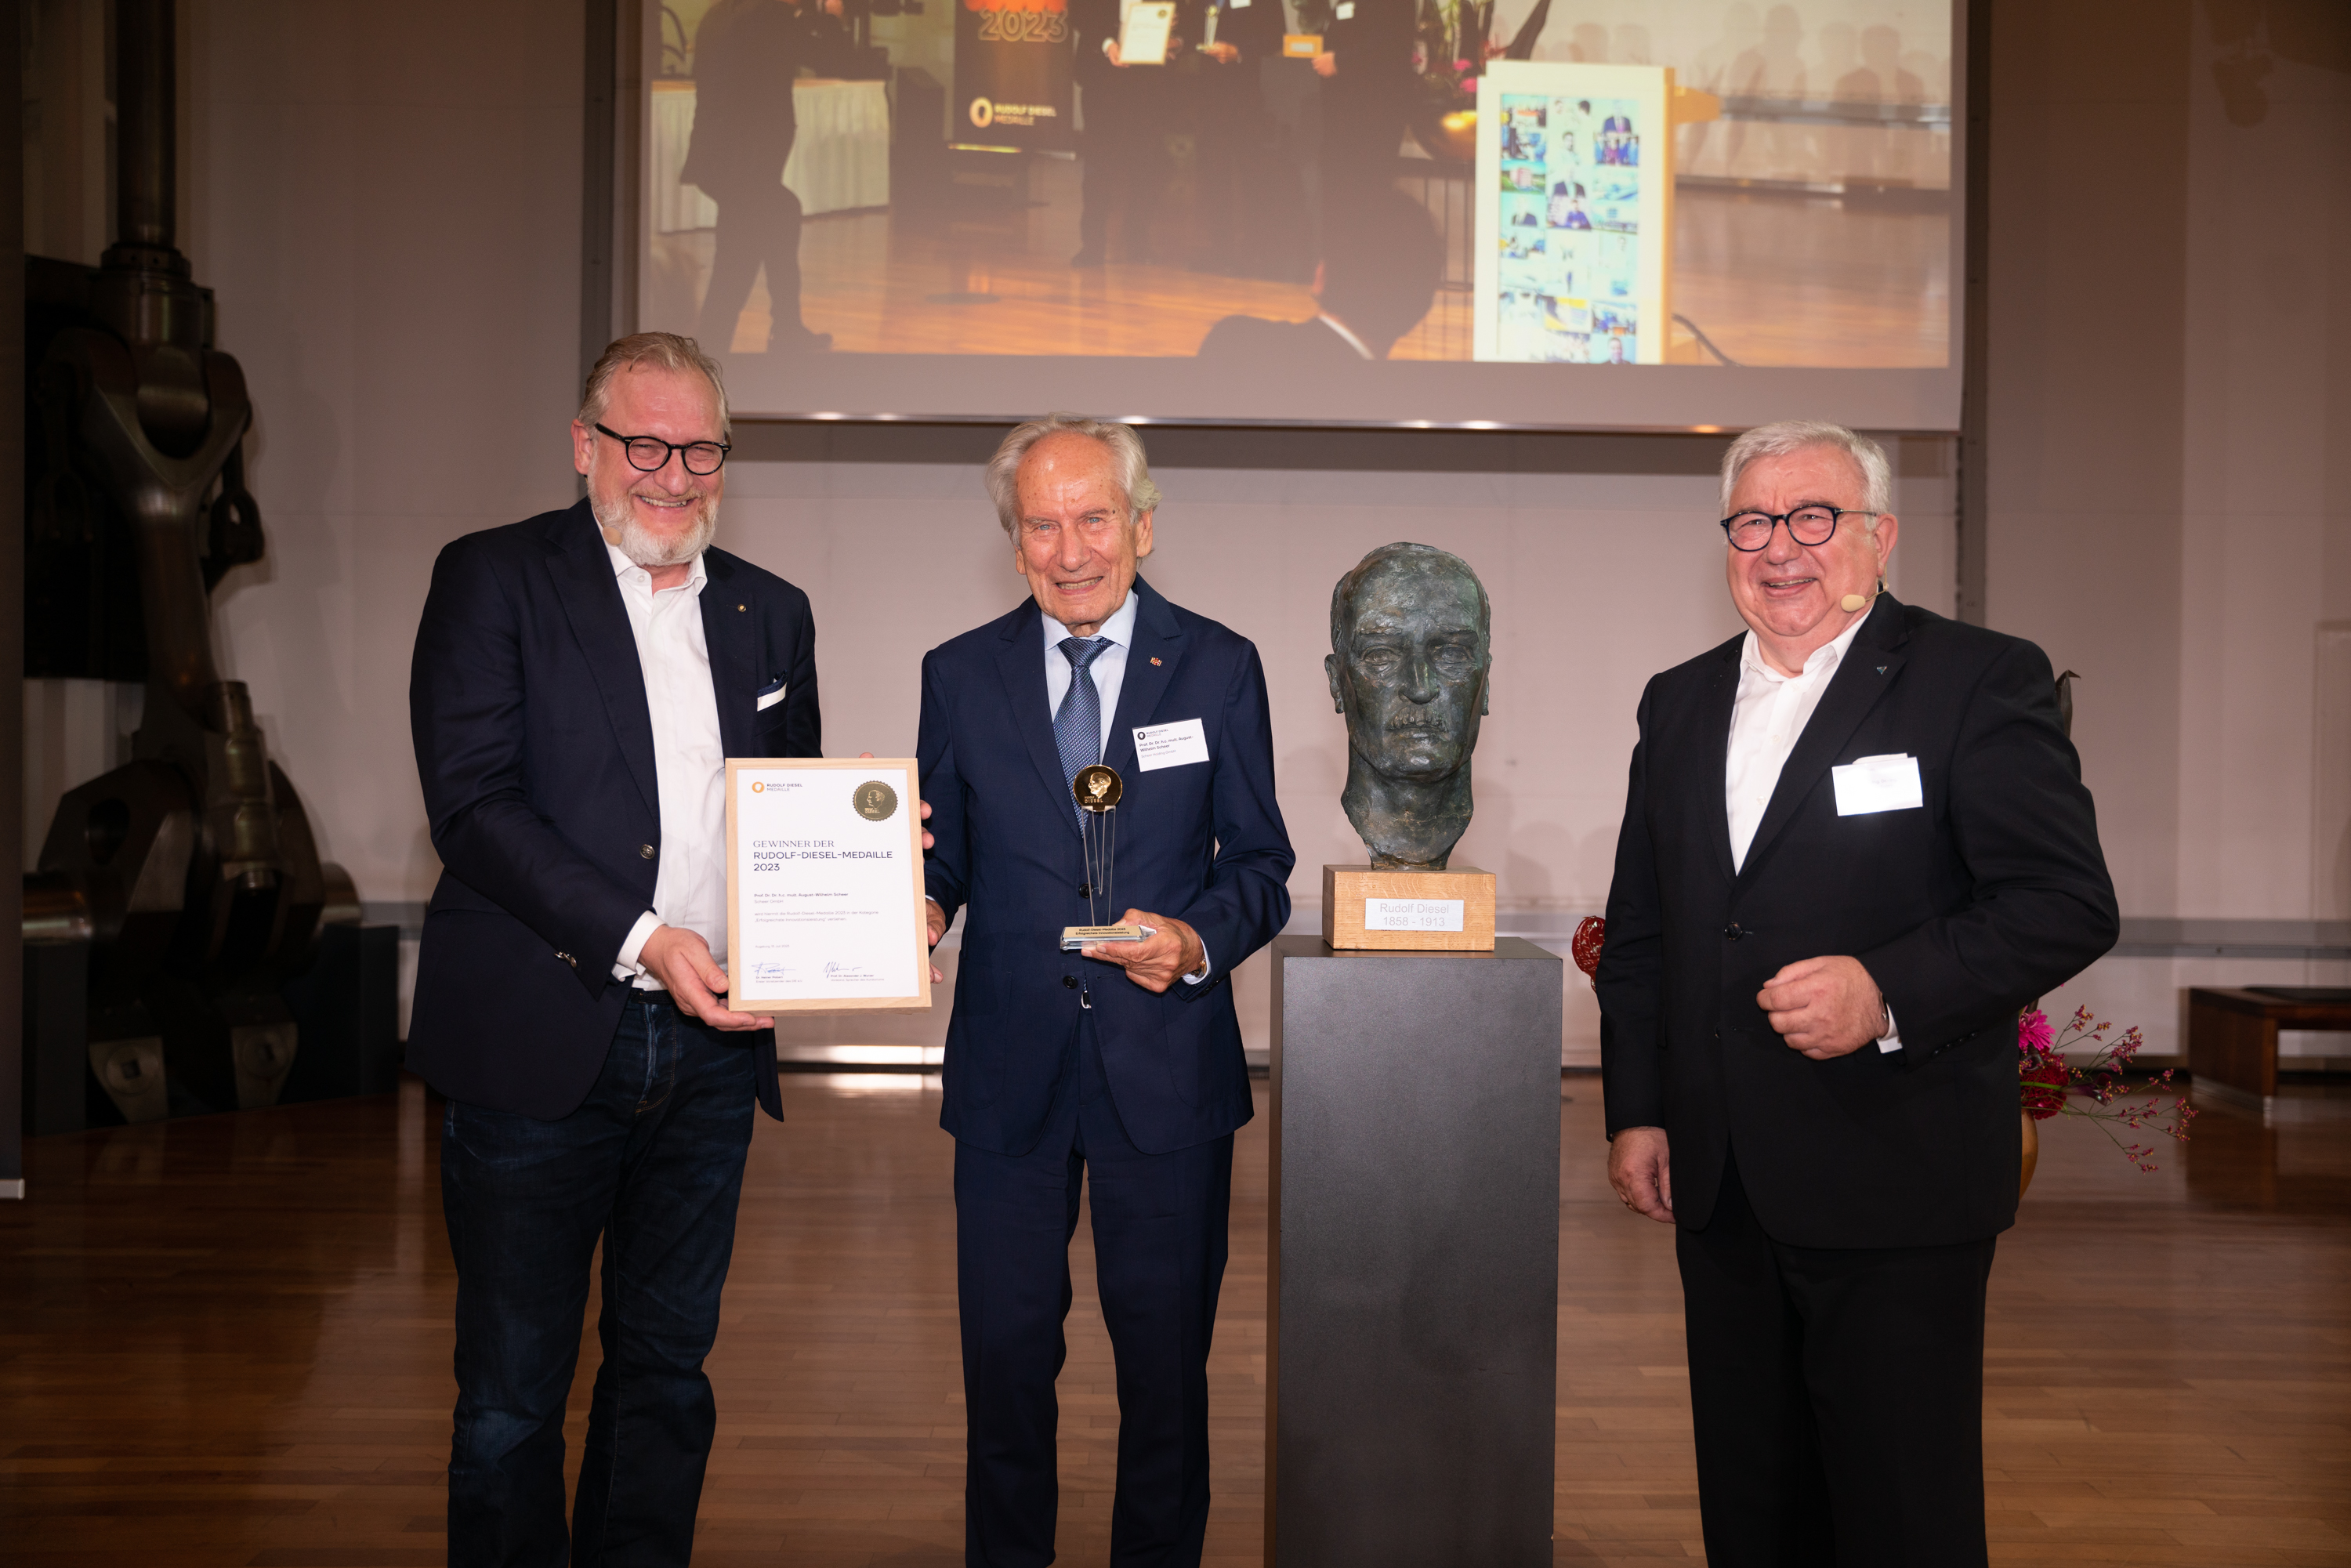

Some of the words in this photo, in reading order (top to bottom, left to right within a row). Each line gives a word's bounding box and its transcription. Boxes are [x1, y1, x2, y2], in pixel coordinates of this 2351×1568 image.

[978, 6, 1068, 43] 2023
[1380, 903, 1414, 913] Rudolf
[1417, 904, 1449, 914] Diesel
[1383, 916, 1408, 926] 1858
[1420, 917, 1445, 927] 1913
